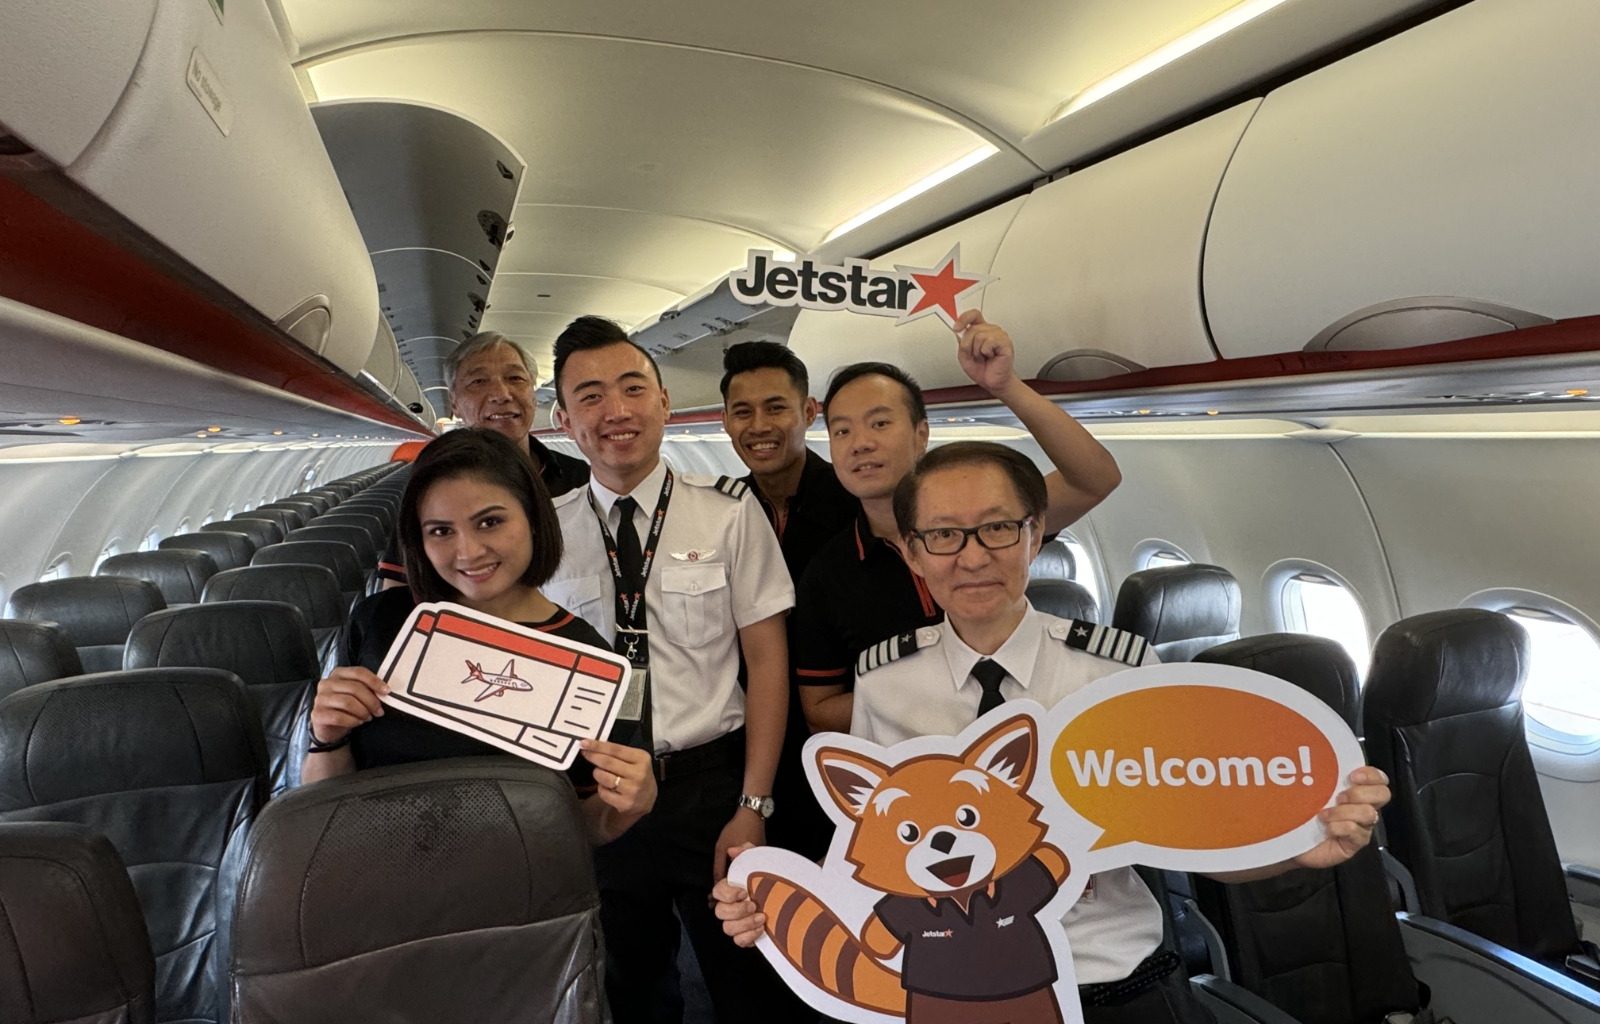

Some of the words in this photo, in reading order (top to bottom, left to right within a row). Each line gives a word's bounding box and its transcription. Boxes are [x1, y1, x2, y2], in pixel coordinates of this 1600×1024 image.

[736, 255, 918, 311] Jetstar
[652, 516, 663, 537] Jetstar
[613, 557, 623, 578] Jetstar
[640, 557, 651, 578] Jetstar
[1066, 745, 1314, 787] Welcome!
[922, 930, 946, 938] Jetstar
